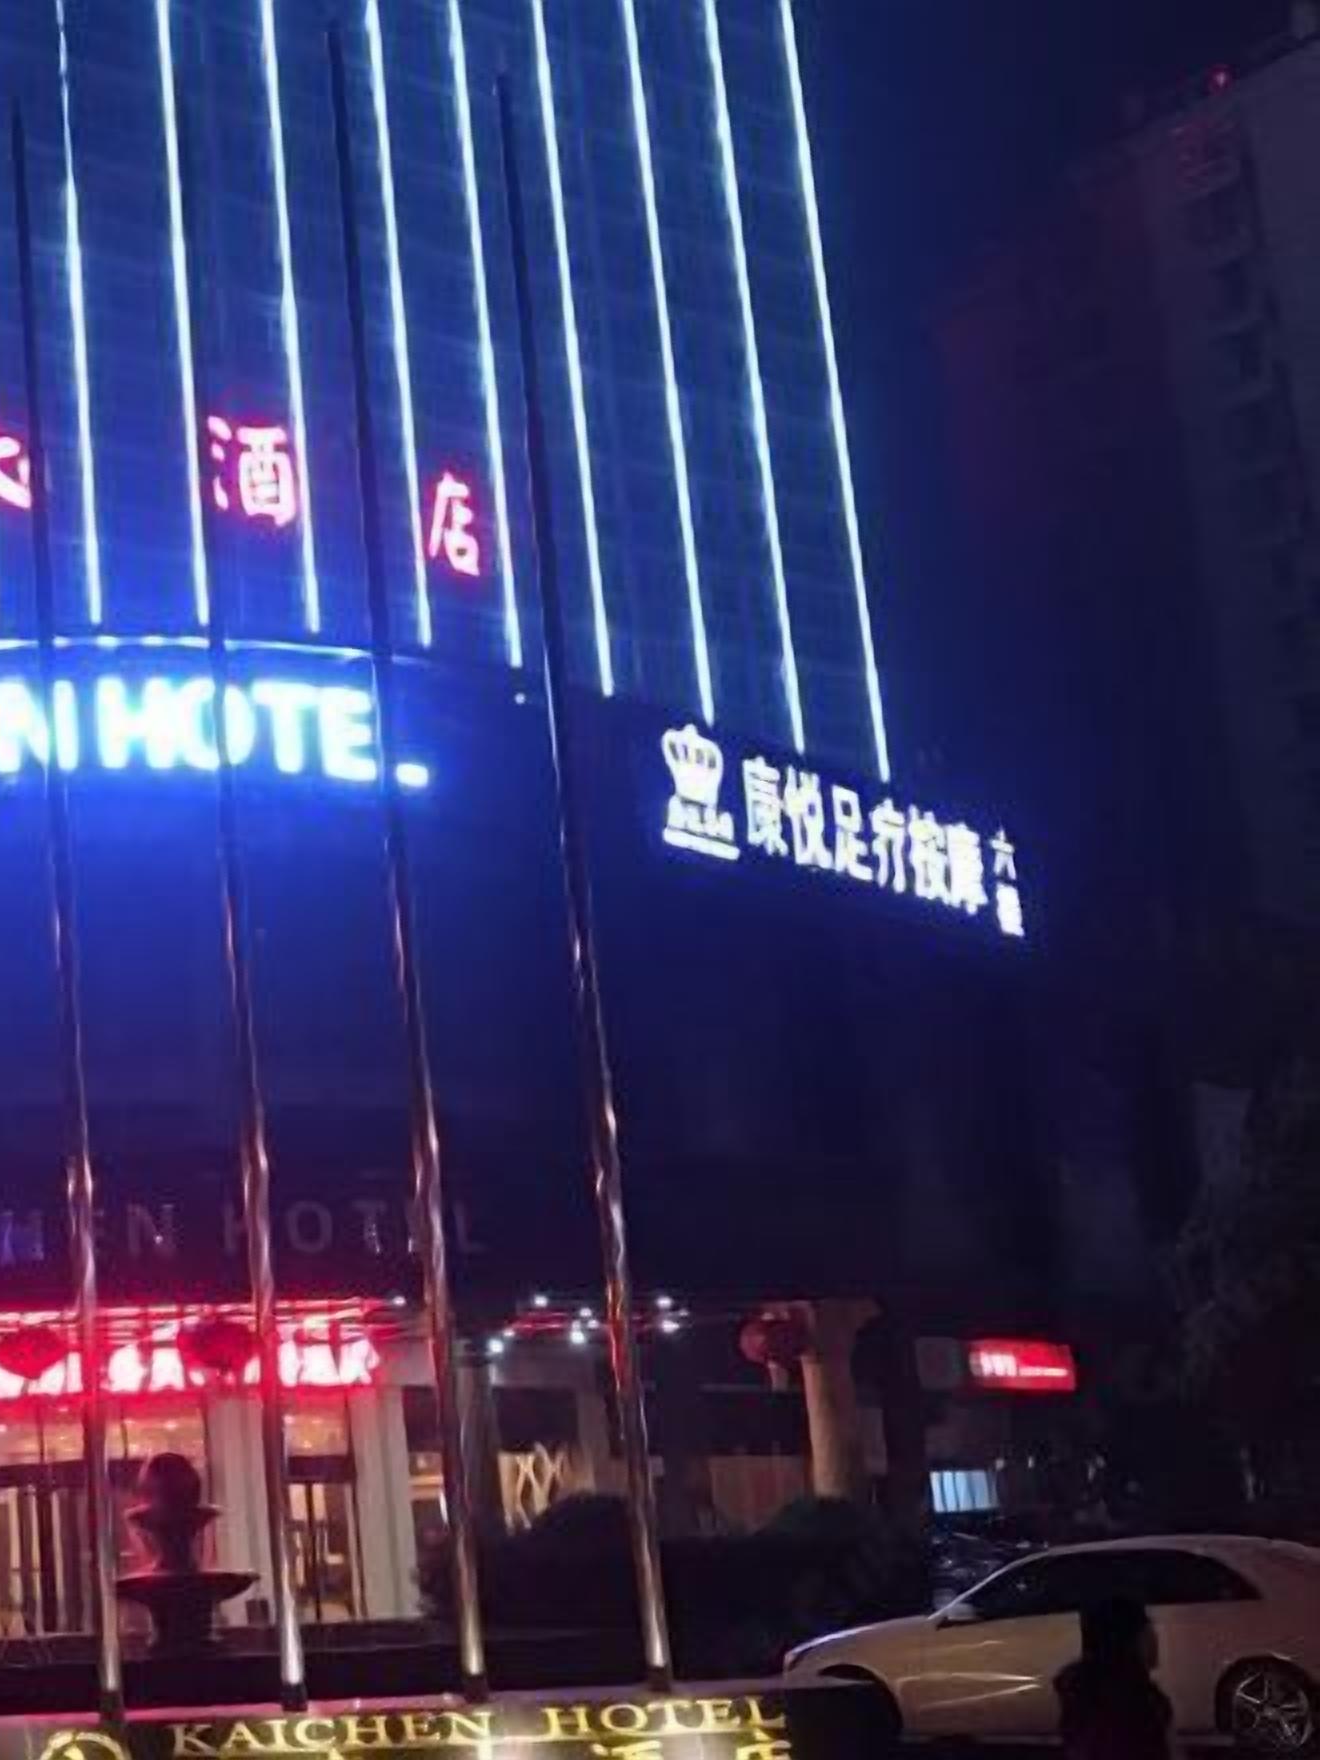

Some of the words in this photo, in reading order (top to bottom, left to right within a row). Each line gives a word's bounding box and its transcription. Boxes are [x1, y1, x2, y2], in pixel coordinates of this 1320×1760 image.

[96, 675, 430, 788] HOTE
[168, 1708, 493, 1757] KAICHEN
[540, 1696, 784, 1743] HOTEL
